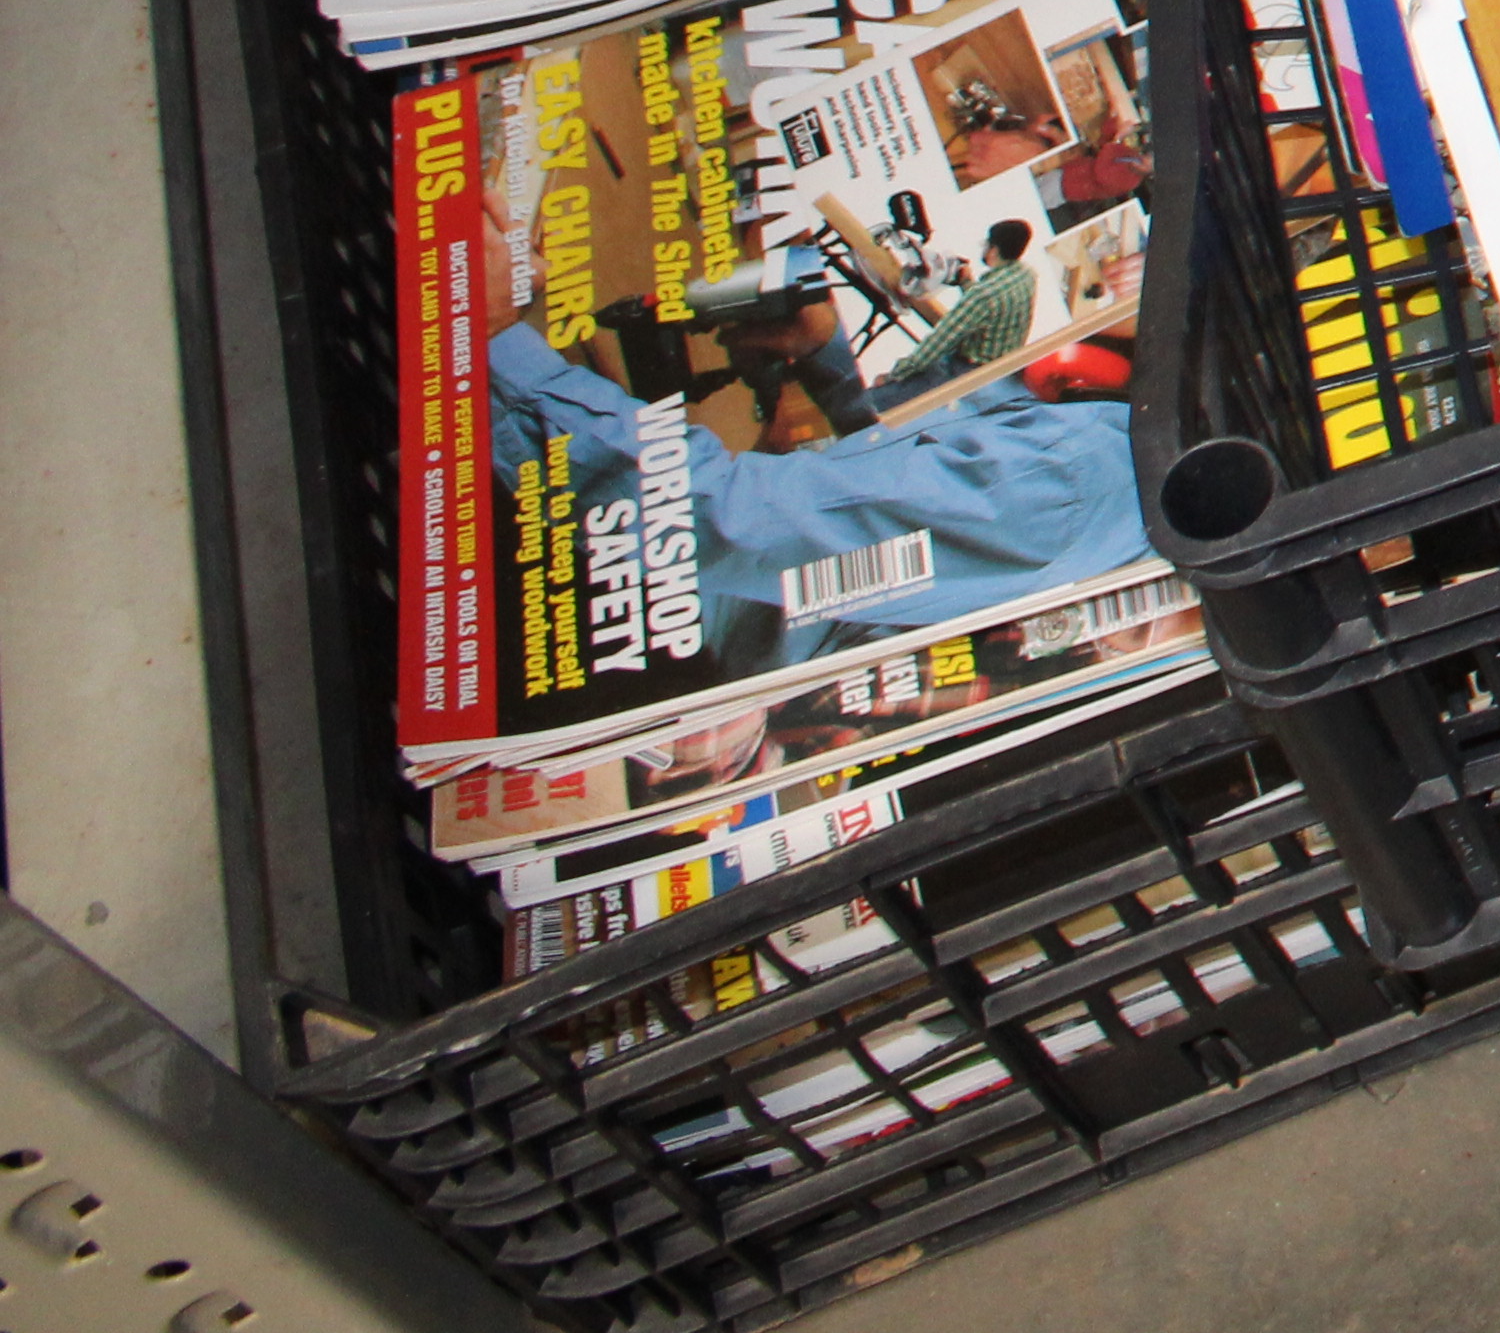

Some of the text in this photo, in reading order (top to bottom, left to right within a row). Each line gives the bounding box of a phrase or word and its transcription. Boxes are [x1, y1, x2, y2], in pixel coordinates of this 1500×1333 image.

[500, 72, 536, 311] for kitchen garden
[533, 54, 596, 354] EASY CHAIRS
[638, 28, 694, 330] made in The Shed
[685, 13, 739, 288] kitchen cabinets
[418, 247, 446, 715] TOY LAND YACHT TO MAKE SCROLLSAW AN INTARSIA DAISY
[448, 239, 478, 710] DOCTOR'S ORDERS PEPPER MILL TO TURN TOOLS ON TRIAL
[510, 456, 553, 699] enjoying woodwork
[545, 431, 585, 696] how to keep yourself
[583, 493, 646, 686] SAFETY
[634, 388, 702, 670] WORKSHOP
